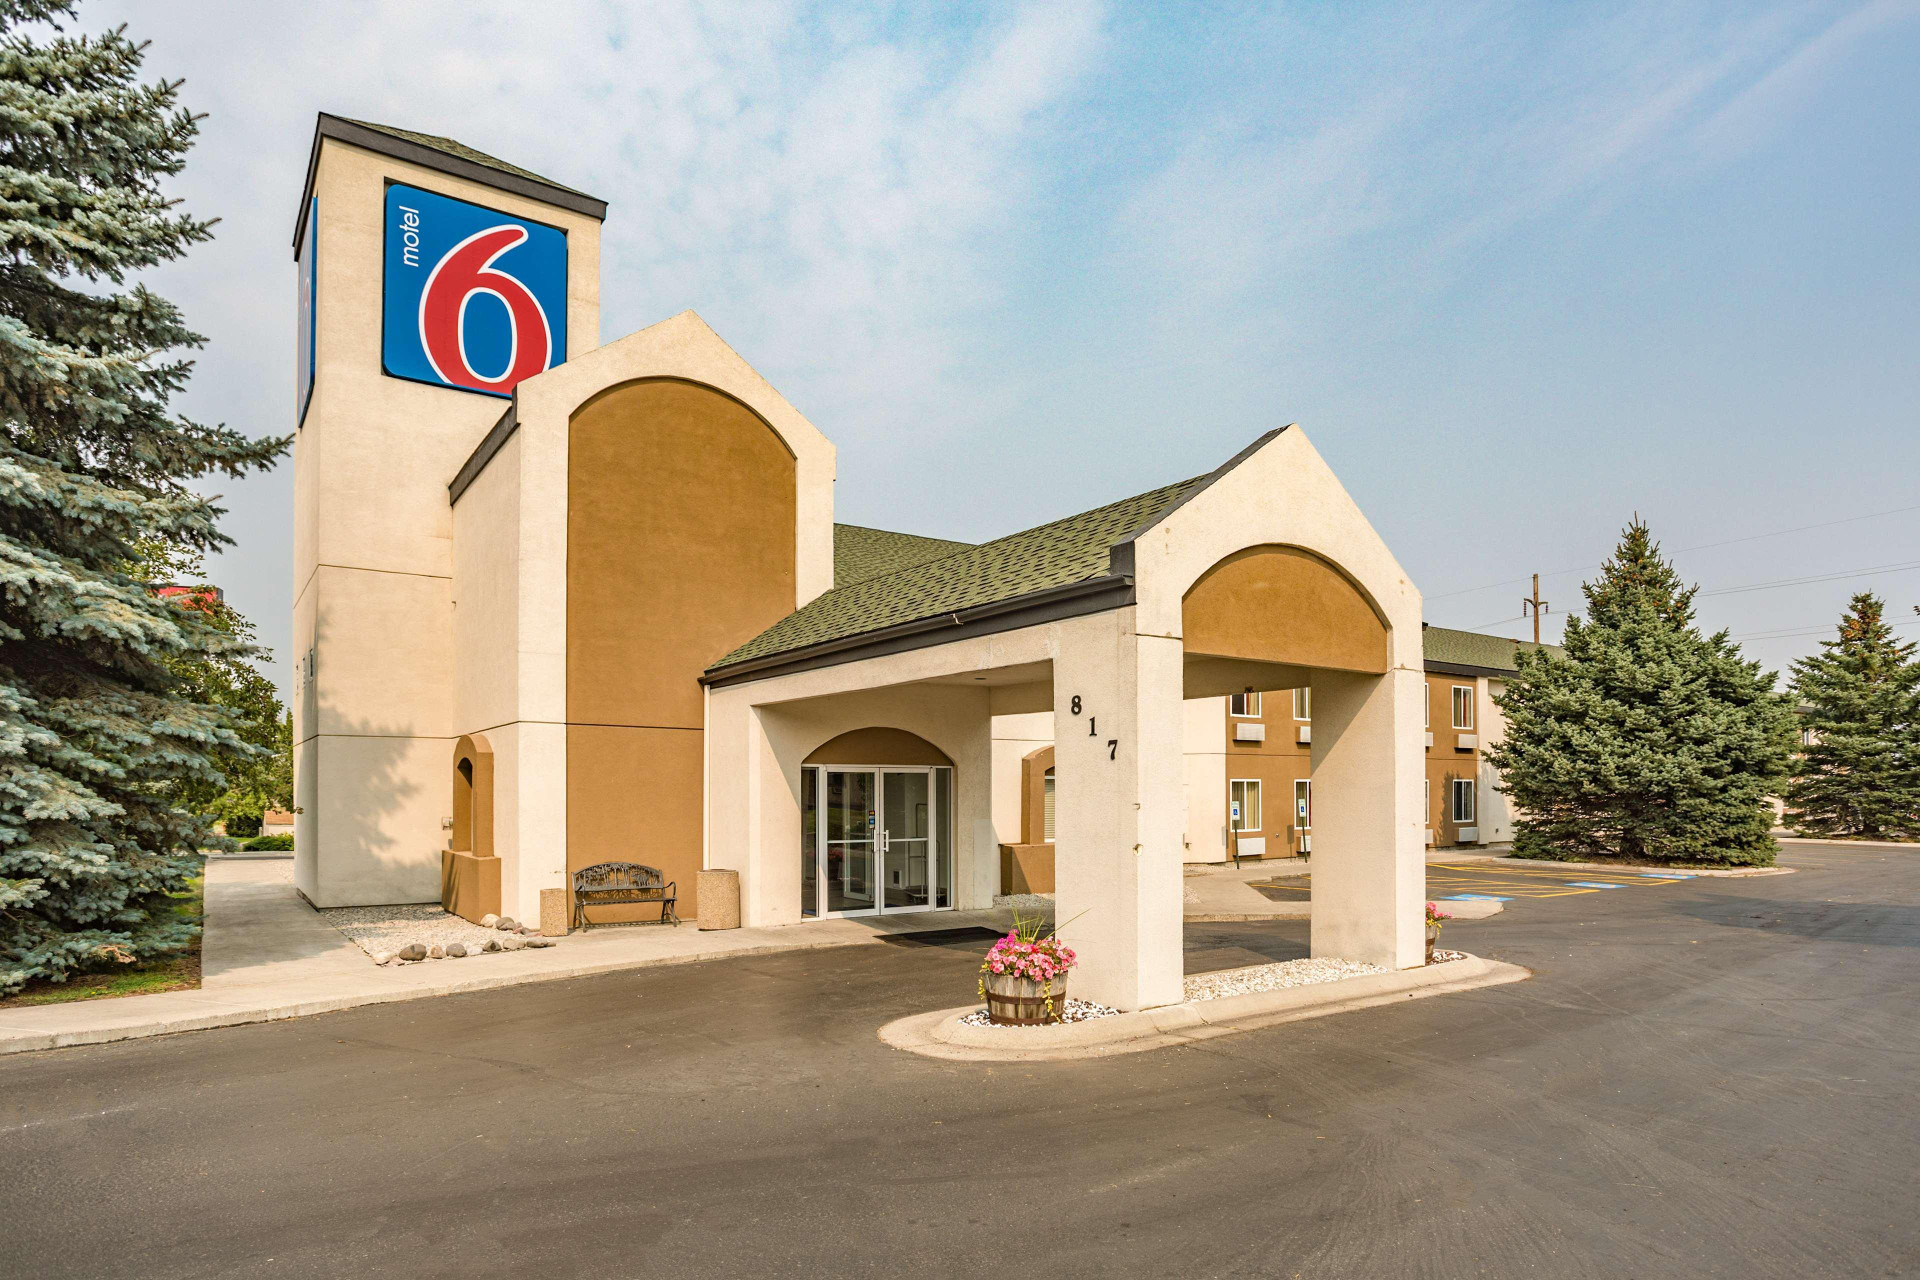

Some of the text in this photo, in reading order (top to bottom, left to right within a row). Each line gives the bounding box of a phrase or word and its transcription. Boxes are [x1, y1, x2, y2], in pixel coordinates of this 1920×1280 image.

[398, 205, 420, 268] motel
[418, 223, 552, 396] 6
[1070, 694, 1119, 761] 817
